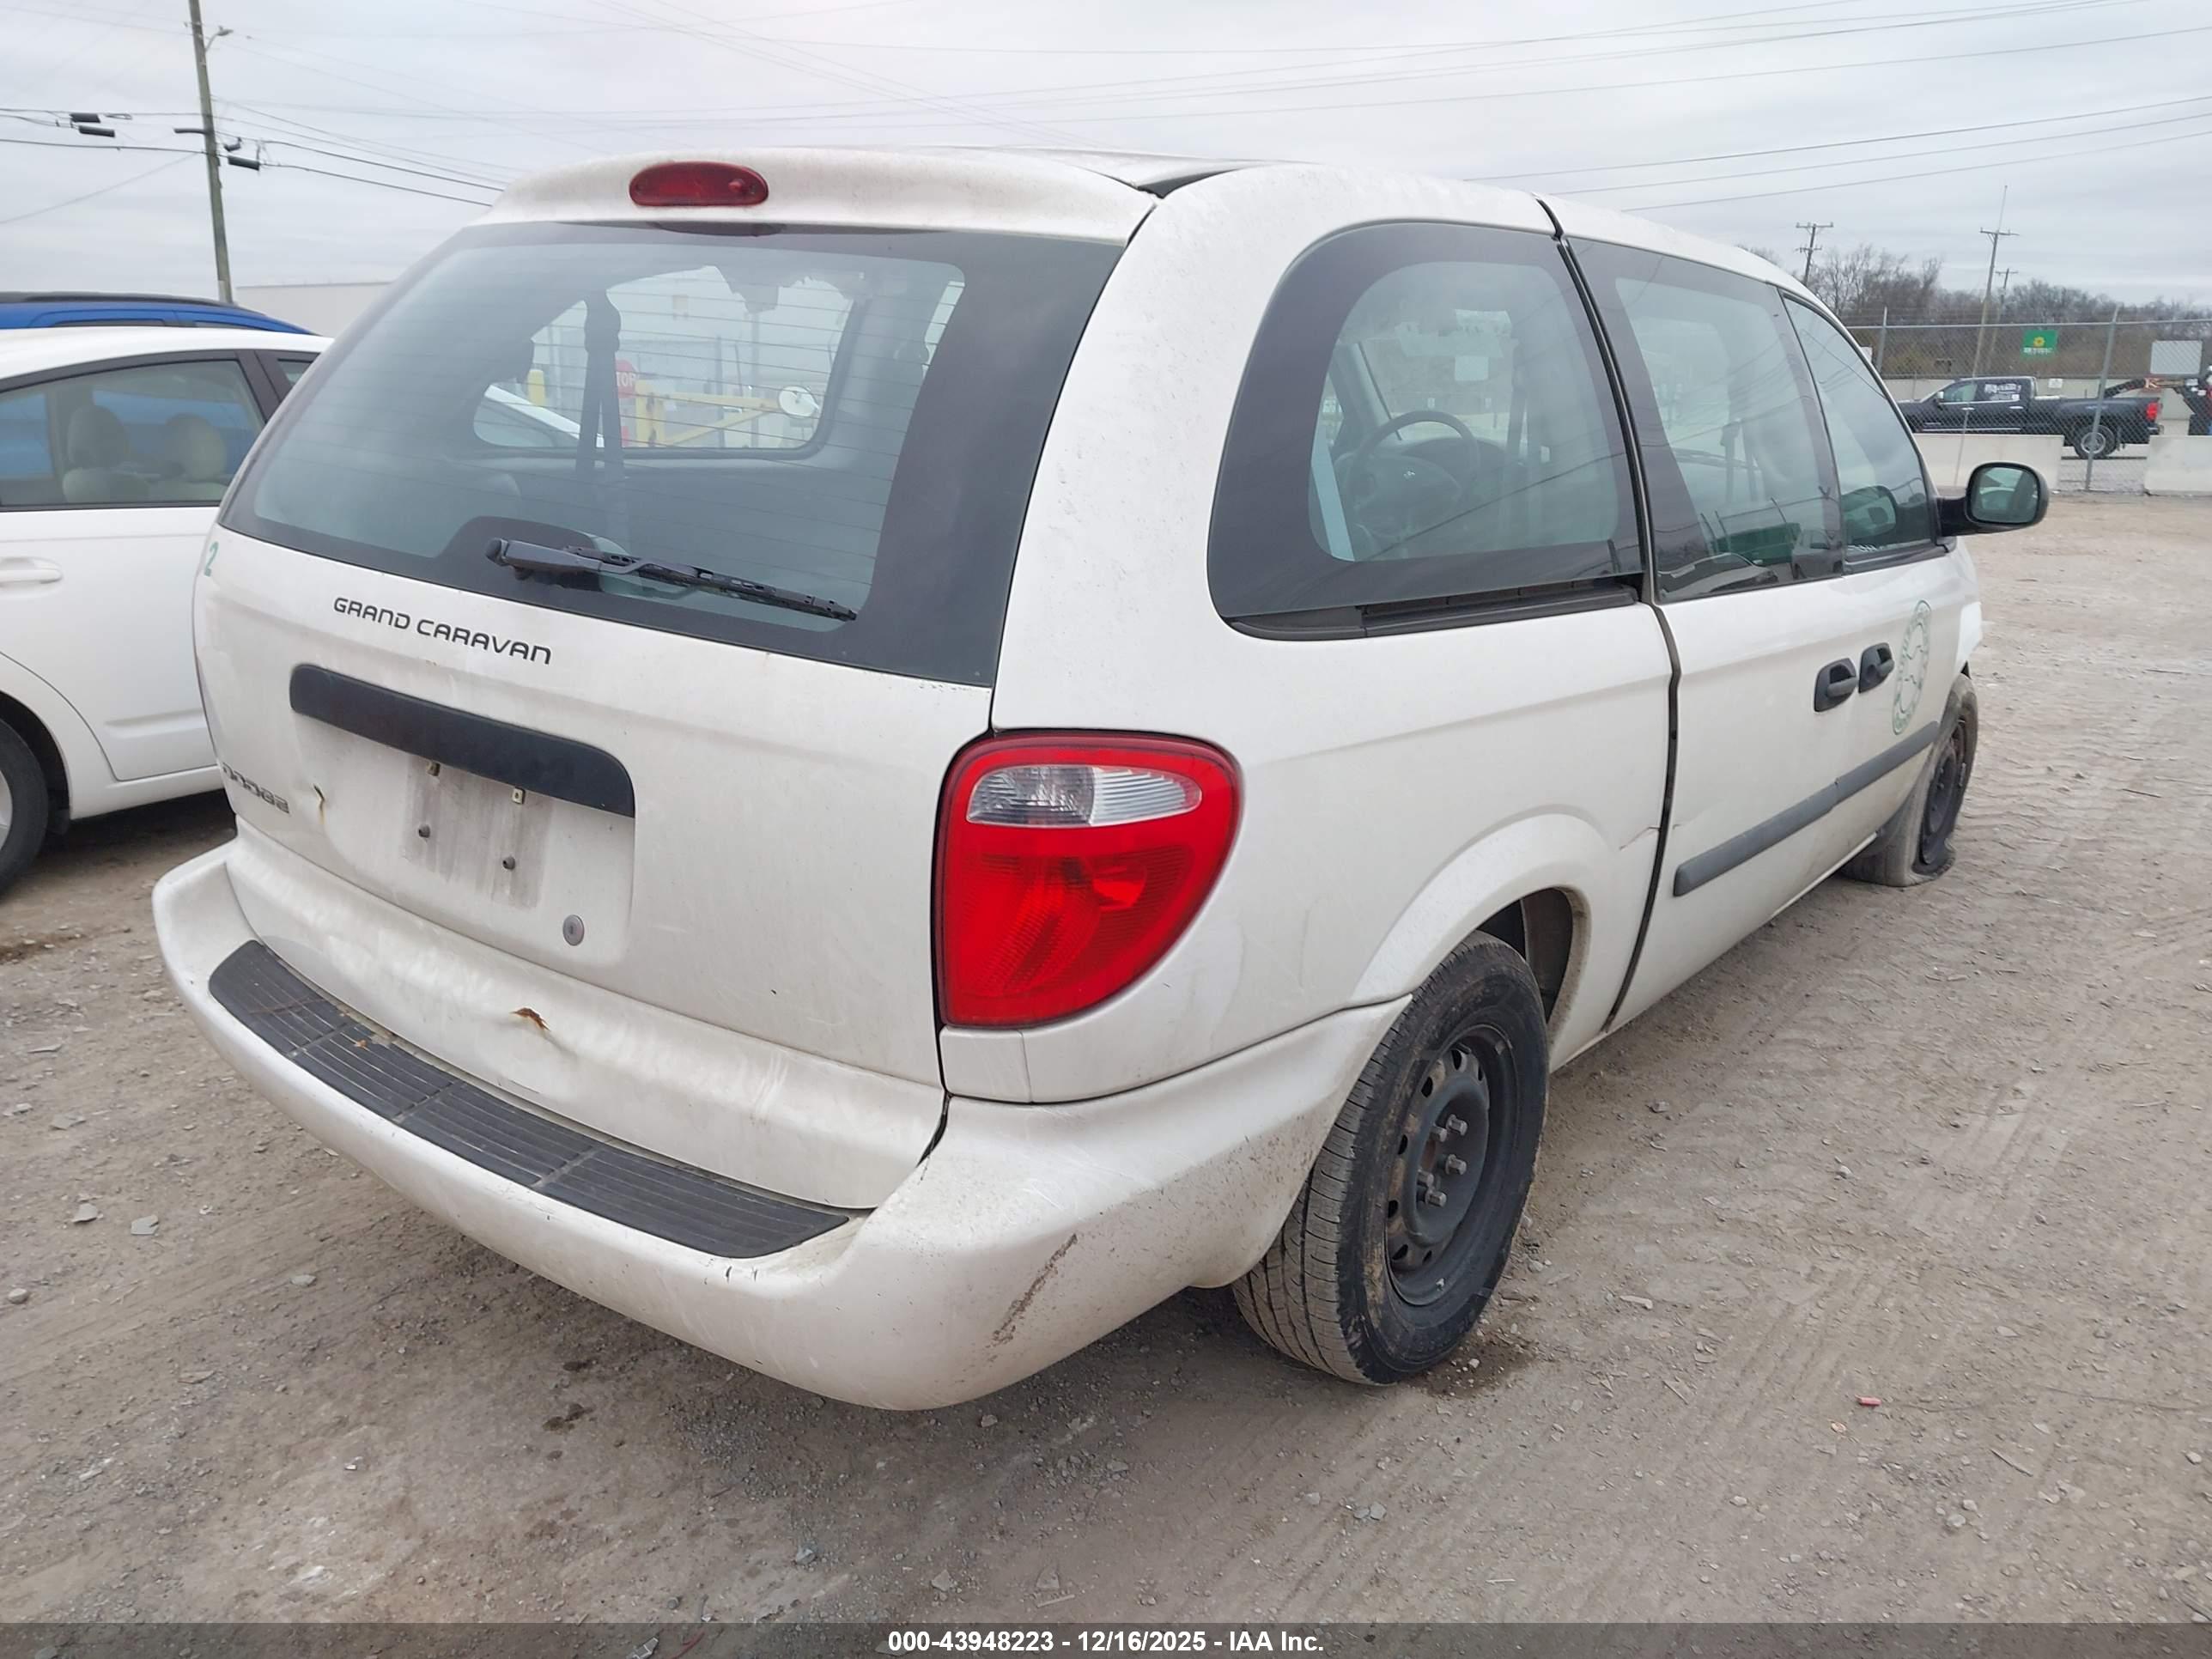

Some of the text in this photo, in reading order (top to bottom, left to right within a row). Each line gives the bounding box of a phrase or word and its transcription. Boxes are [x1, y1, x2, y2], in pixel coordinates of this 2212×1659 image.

[615, 371, 637, 387] TOP
[333, 597, 552, 665] GRAND CARAVAN
